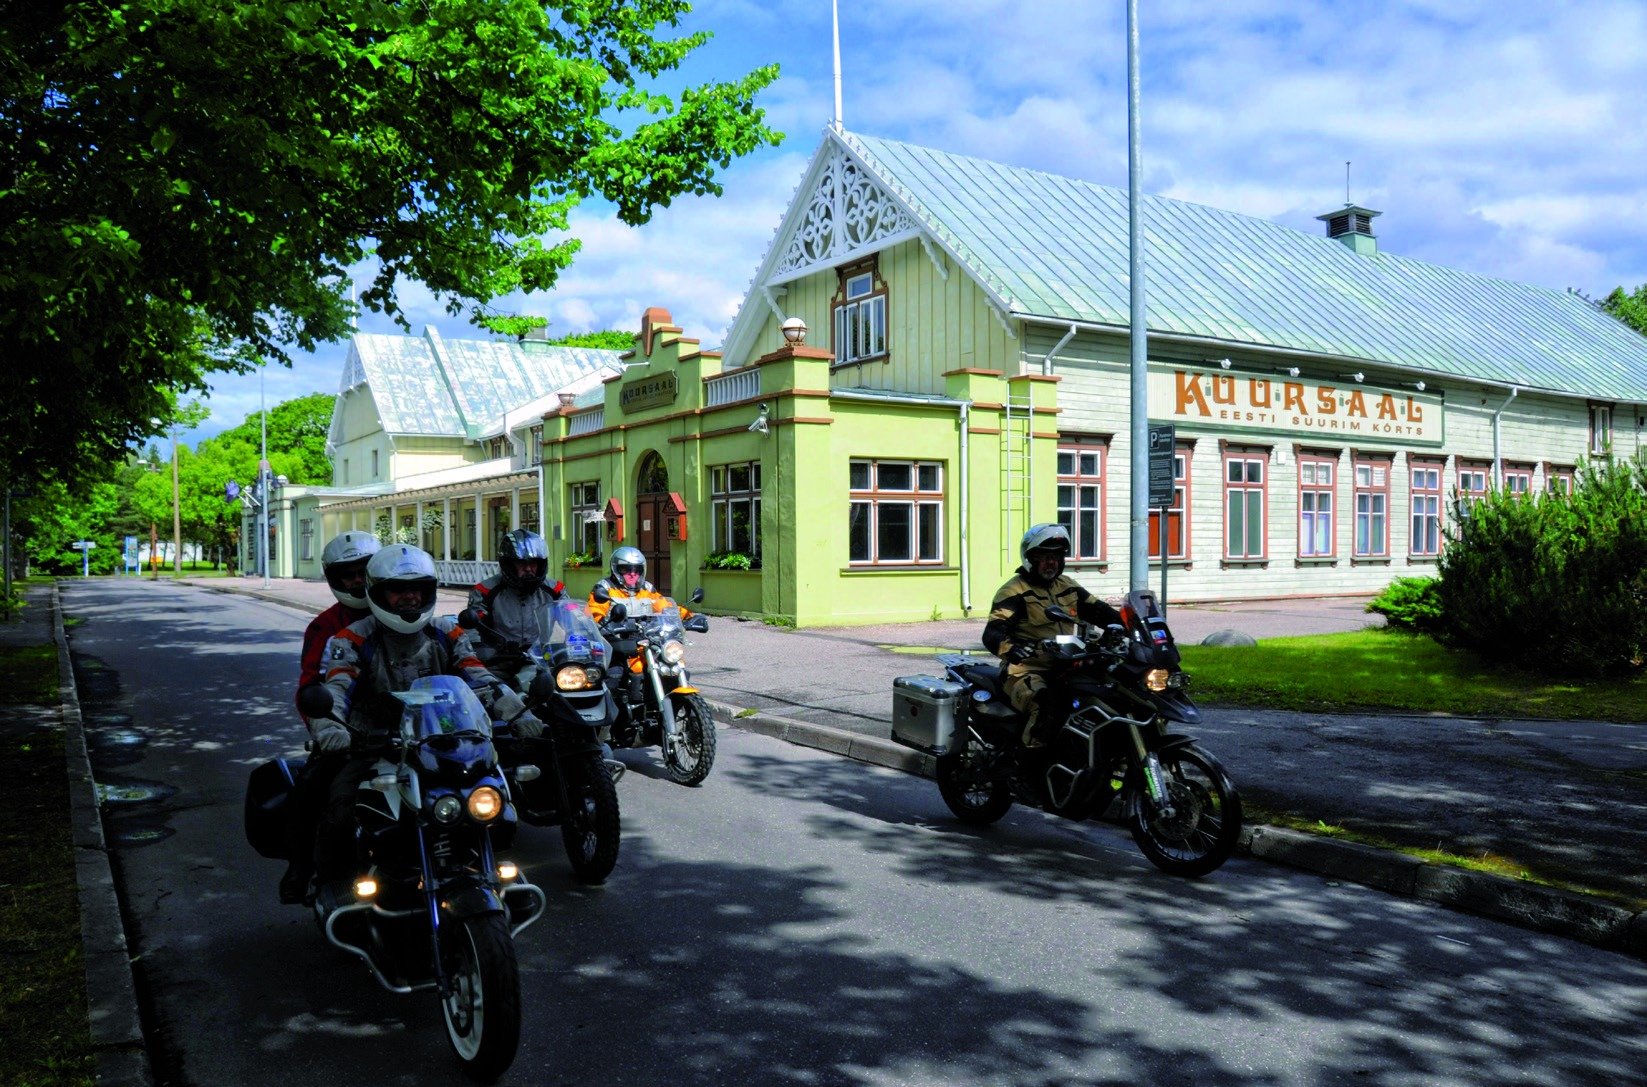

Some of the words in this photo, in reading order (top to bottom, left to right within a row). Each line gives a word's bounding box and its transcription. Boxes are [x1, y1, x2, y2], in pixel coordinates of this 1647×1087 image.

[1174, 370, 1423, 423] KUURSAAL
[1219, 409, 1276, 423] EESTI
[1291, 415, 1361, 431] SUURIM
[1150, 431, 1158, 448] P
